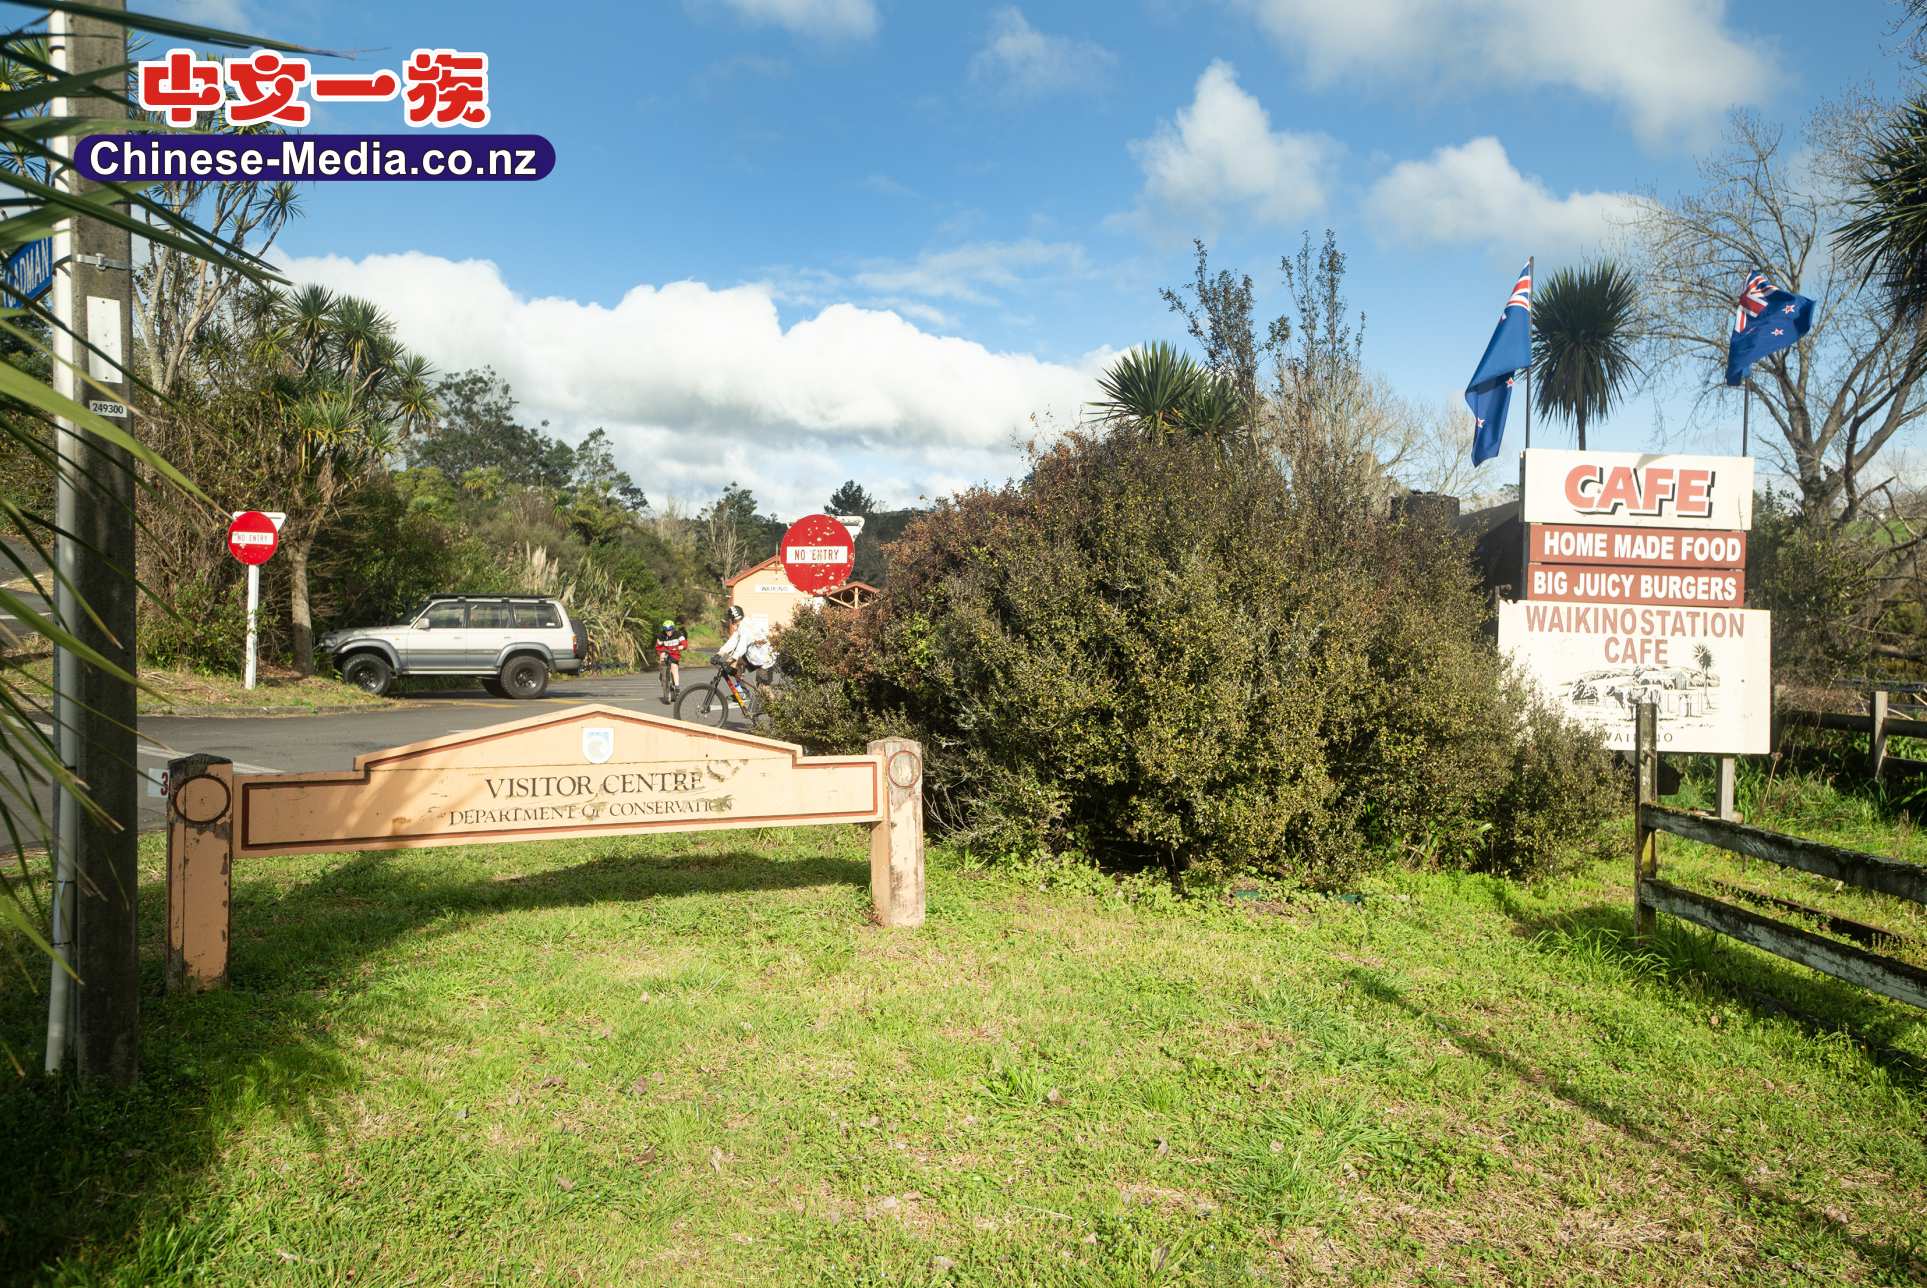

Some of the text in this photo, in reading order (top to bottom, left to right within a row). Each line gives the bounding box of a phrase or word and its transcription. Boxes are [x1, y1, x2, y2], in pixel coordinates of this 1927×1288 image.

[92, 402, 124, 415] 249300
[1564, 464, 1716, 518] CAFE
[794, 549, 839, 561] NO ENTRY
[1544, 531, 1742, 562] HOME MADE FOOD
[1533, 570, 1737, 601] BIG JUICY BURGERS
[1525, 604, 1745, 639] WAIKINO STATION
[1604, 636, 1669, 665] CAFE
[485, 770, 704, 799] VISITOR CENTRE
[449, 804, 576, 826] DEPARTMENT
